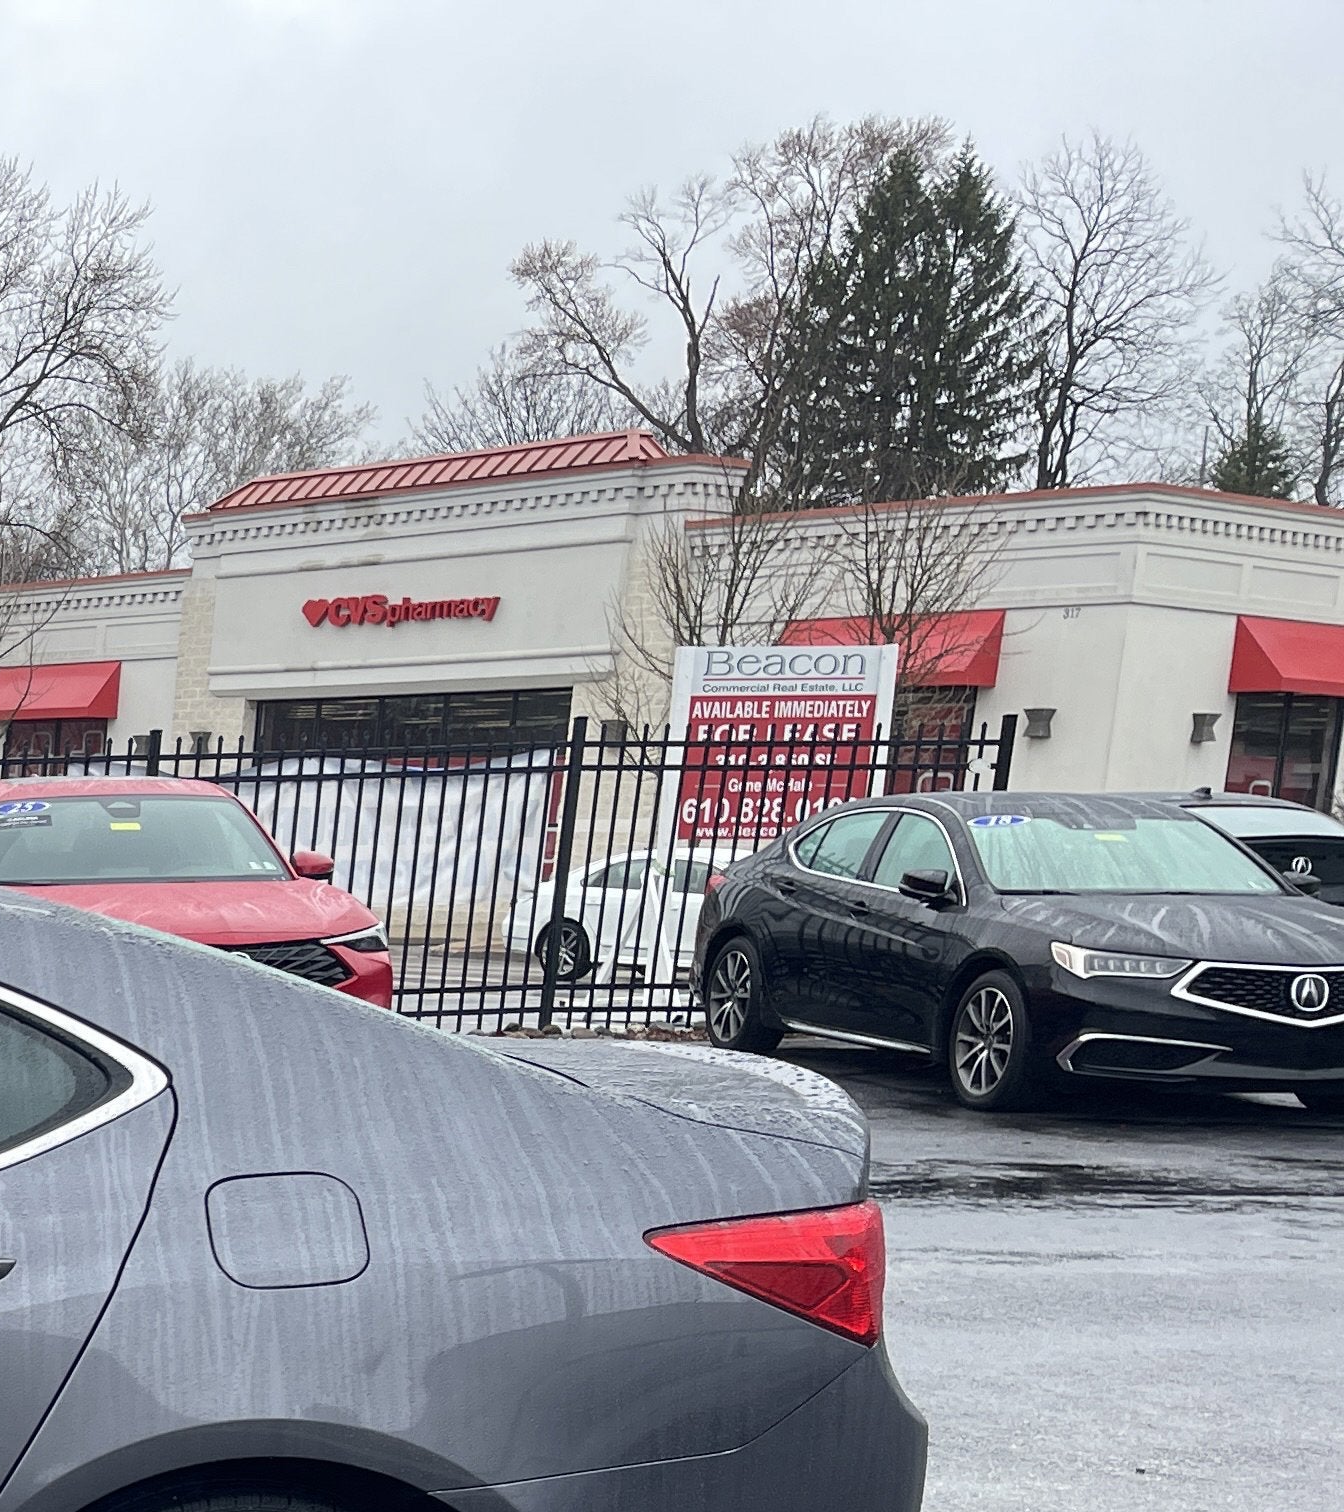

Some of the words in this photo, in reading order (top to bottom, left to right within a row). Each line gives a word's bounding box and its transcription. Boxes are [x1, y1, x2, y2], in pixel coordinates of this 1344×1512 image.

[1063, 607, 1081, 620] 317
[703, 650, 867, 677] Beacon
[702, 684, 769, 694] Commercial
[773, 683, 797, 693] Real
[801, 683, 838, 693] Estate,
[842, 682, 864, 692] LLC
[691, 701, 771, 719] AVAILABLE
[774, 699, 872, 719] IMMEDIATELY
[682, 797, 858, 824] 610.828.01
